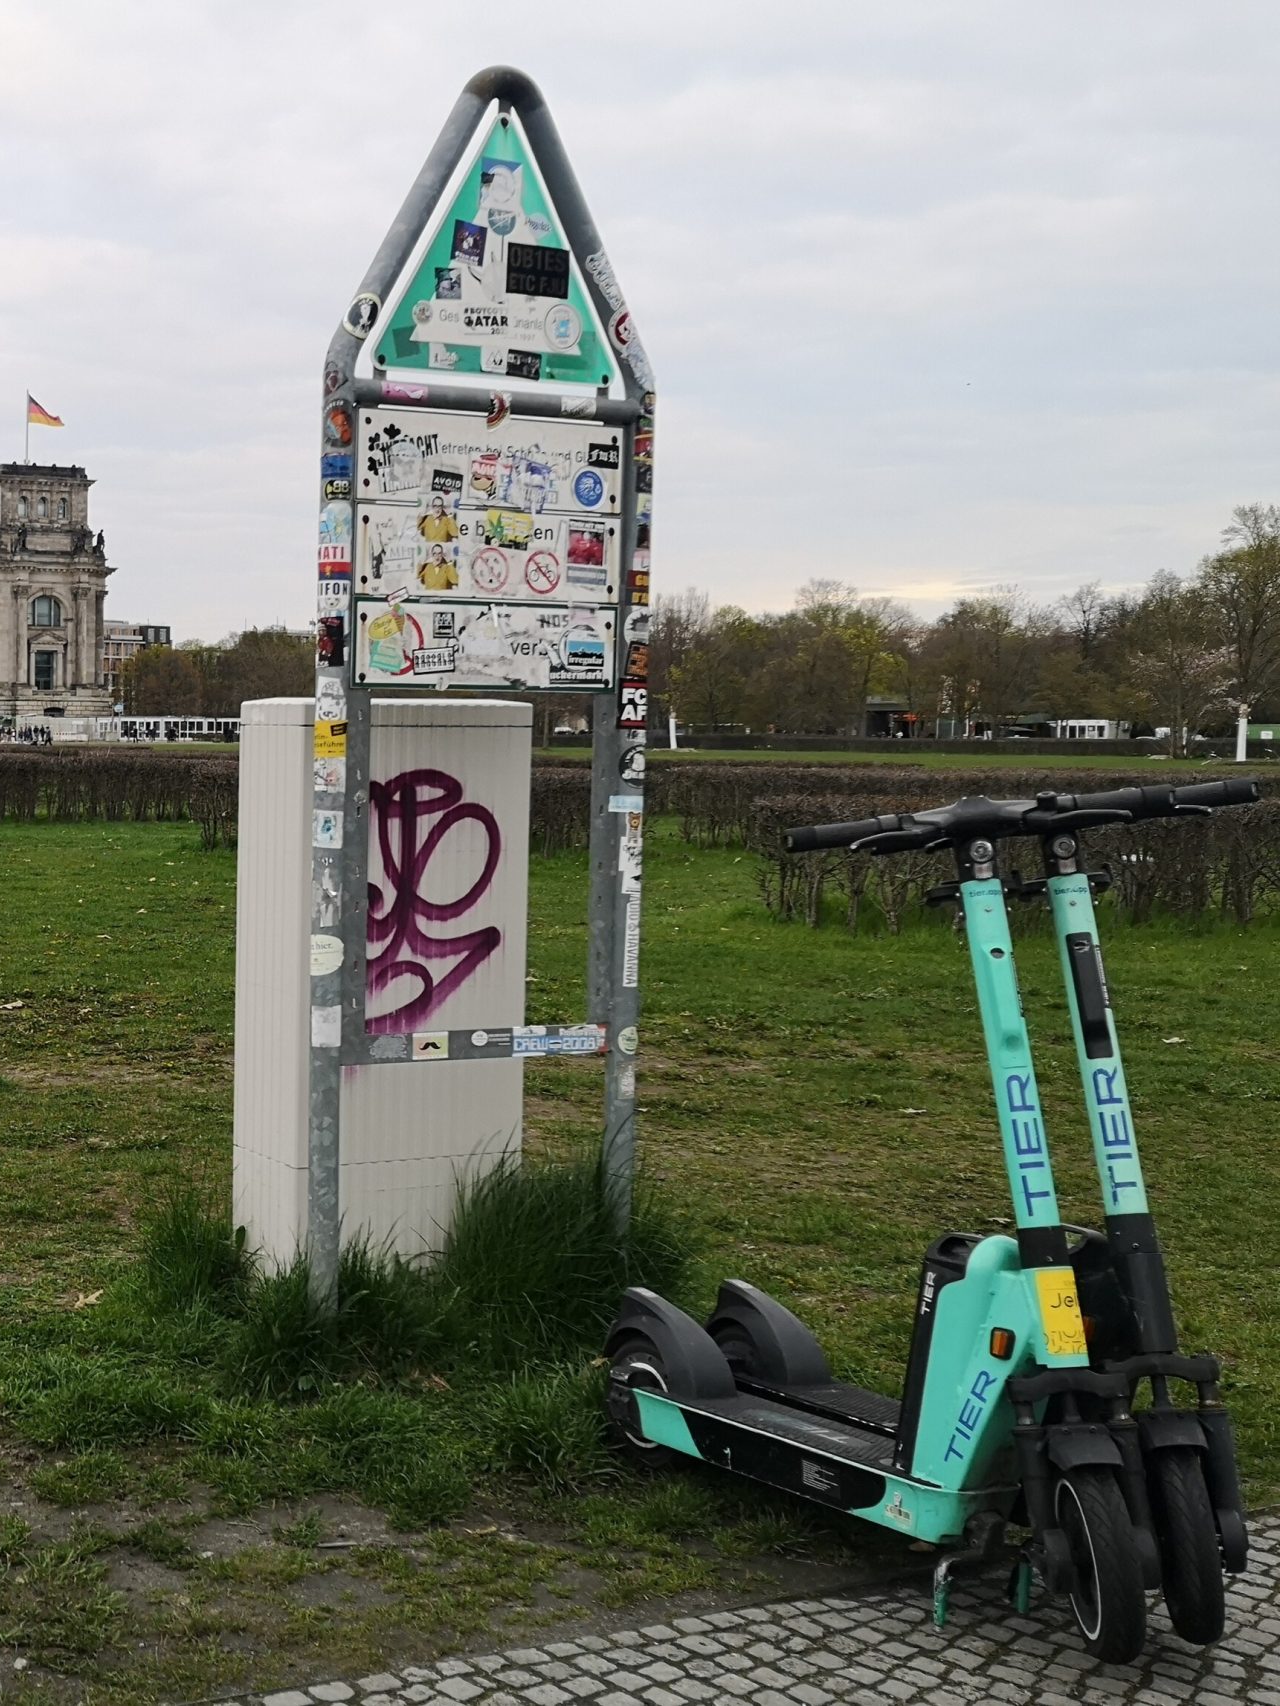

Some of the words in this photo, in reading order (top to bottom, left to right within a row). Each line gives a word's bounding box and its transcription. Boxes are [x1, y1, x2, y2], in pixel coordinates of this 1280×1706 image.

[463, 315, 508, 328] QATAR
[433, 476, 461, 488] AVOID
[549, 669, 603, 680] uckermark
[622, 688, 647, 704] FC
[621, 705, 648, 721] AF
[625, 933, 639, 985] HAVANNA
[1006, 1073, 1051, 1217] TIER
[1092, 1064, 1137, 1206] TIER
[920, 1271, 937, 1315] TIER
[944, 1370, 998, 1462] TIER
